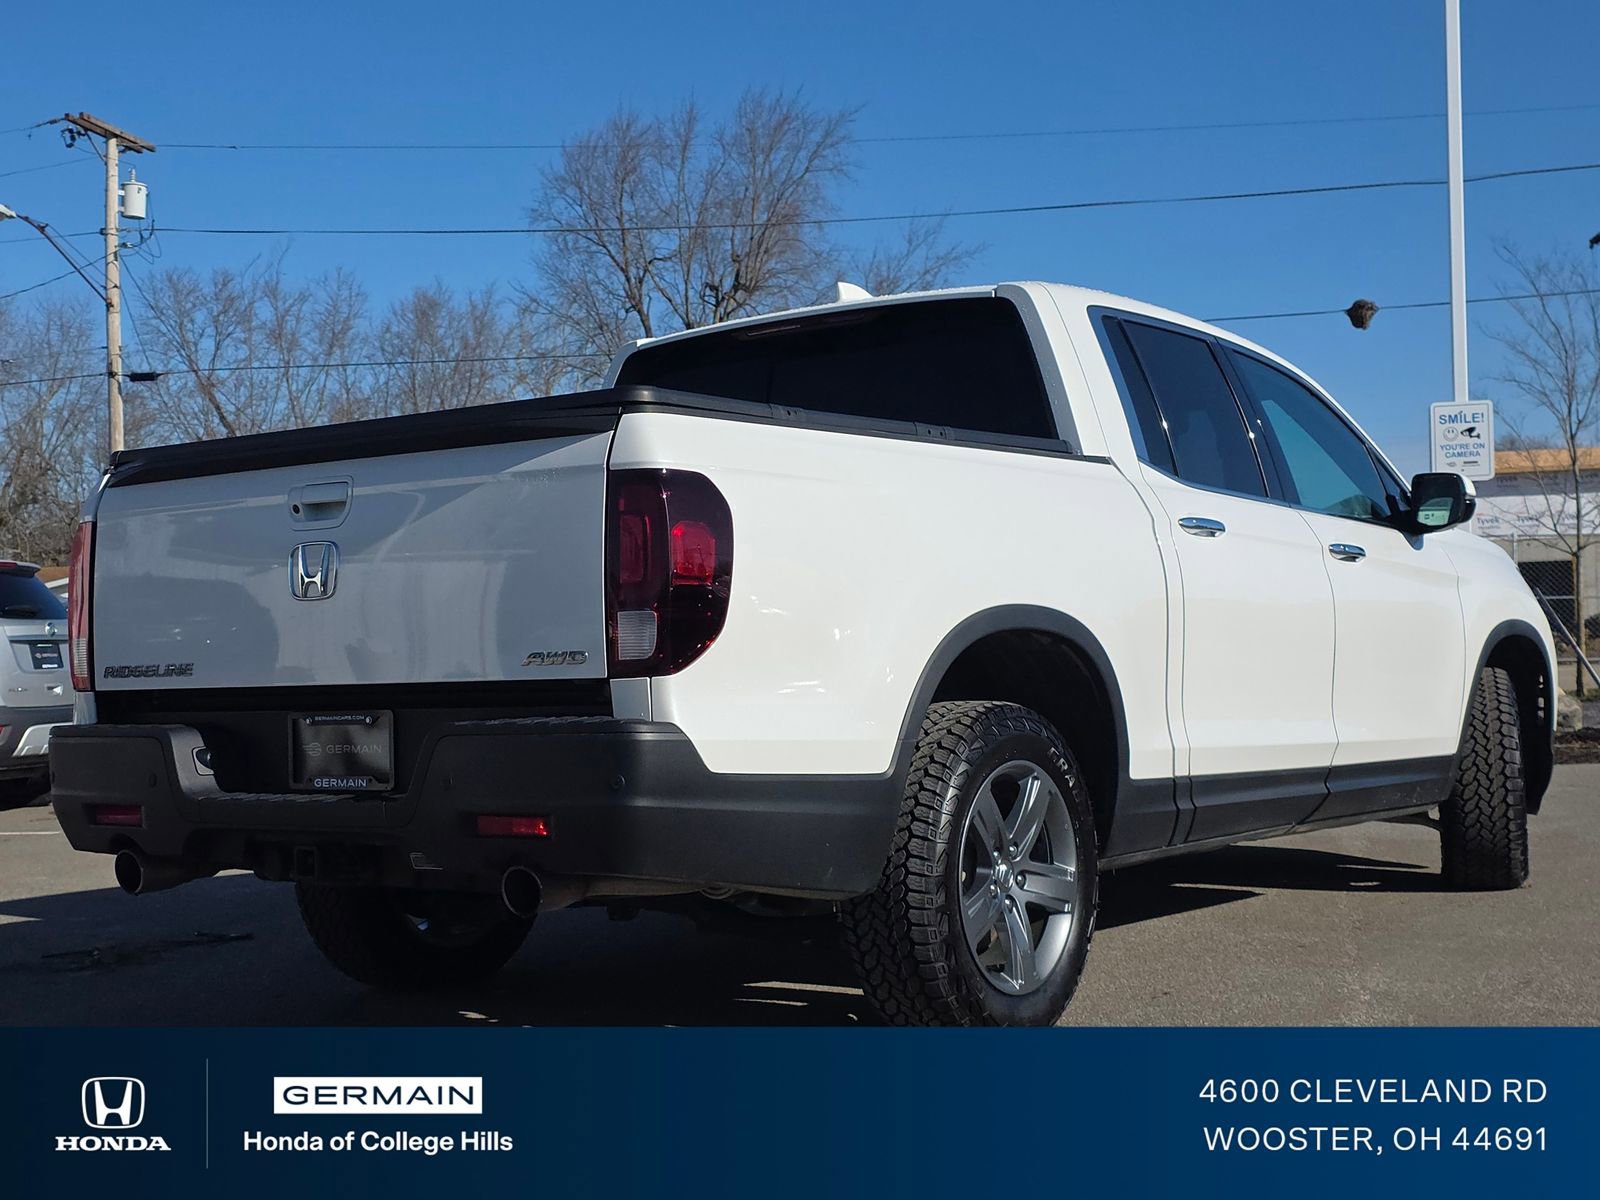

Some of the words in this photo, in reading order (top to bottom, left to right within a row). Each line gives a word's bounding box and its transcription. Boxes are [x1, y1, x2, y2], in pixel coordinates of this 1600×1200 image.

[1439, 411, 1485, 425] SMILE!
[1440, 442, 1470, 451] YOU'RE
[1473, 442, 1485, 450] ON
[1445, 450, 1481, 458] CAMERA
[520, 650, 589, 667] AWD
[103, 663, 194, 679] RIDGELINE
[326, 744, 382, 754] GERMAIN
[313, 778, 368, 788] GERMAIN
